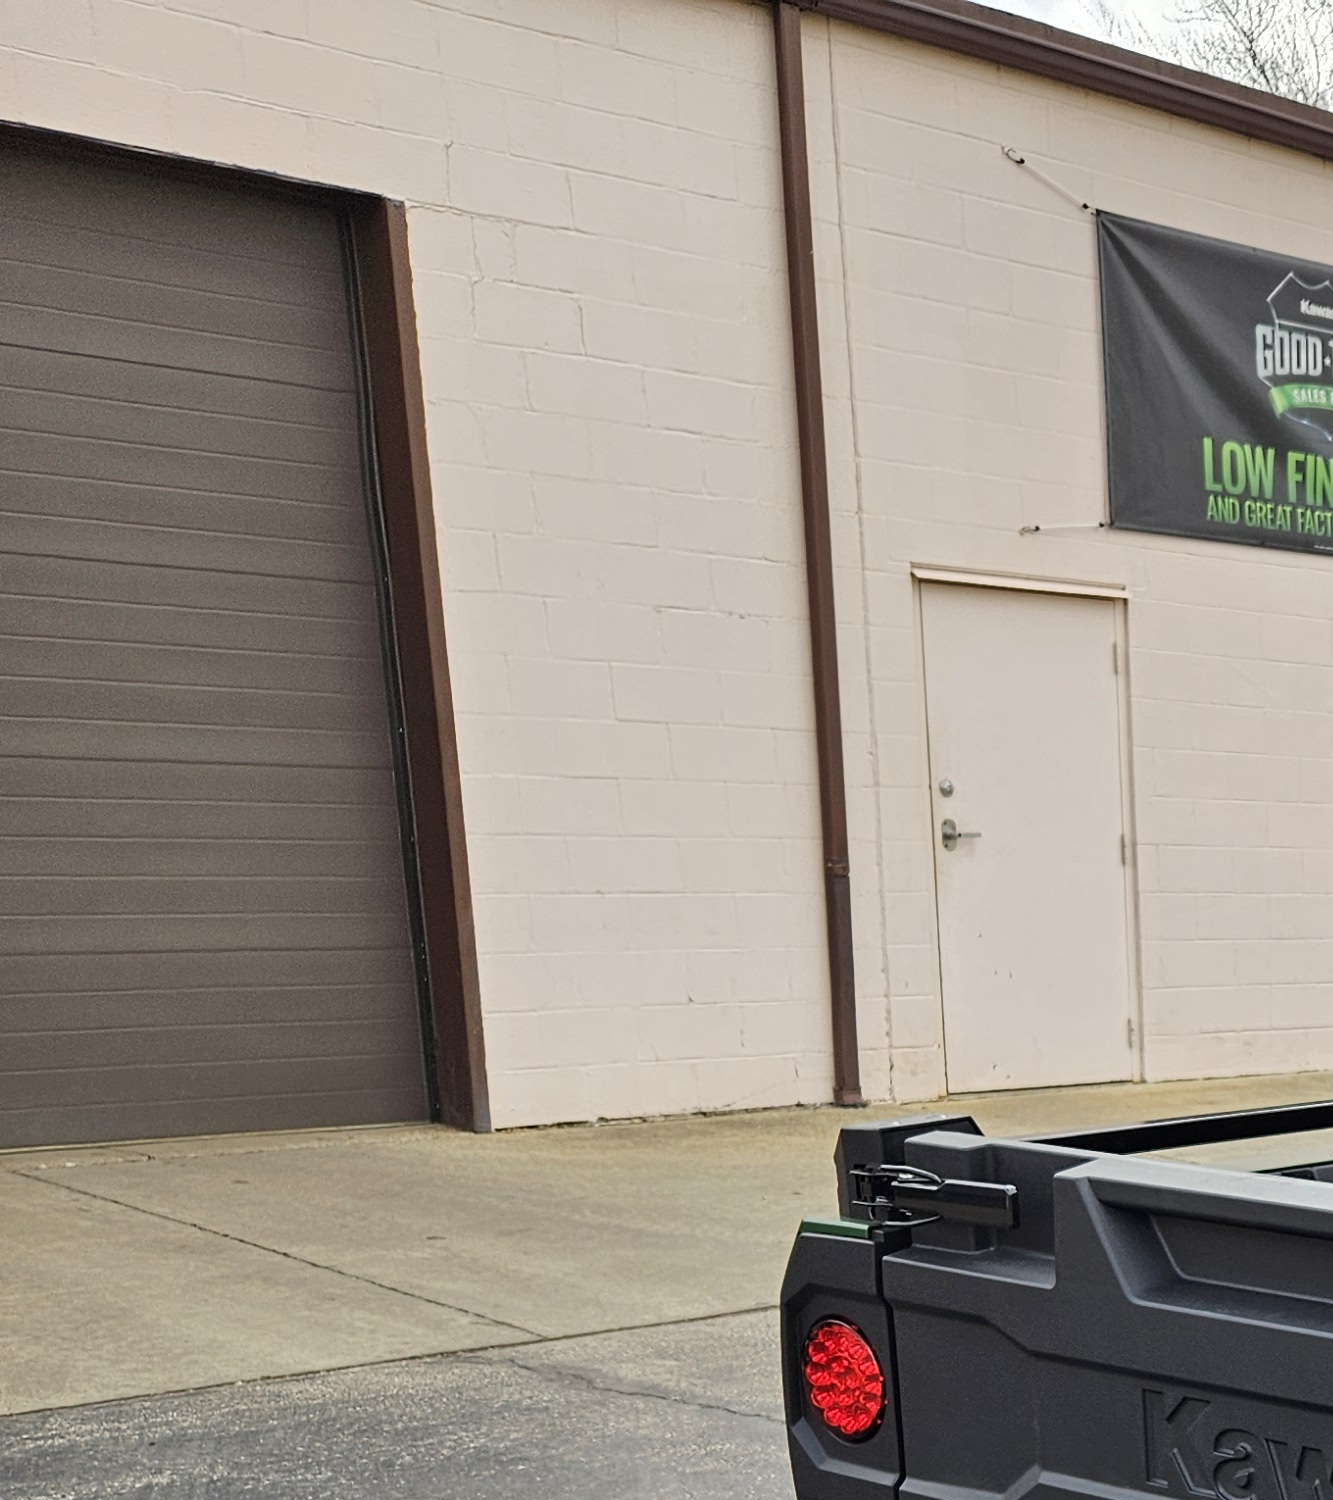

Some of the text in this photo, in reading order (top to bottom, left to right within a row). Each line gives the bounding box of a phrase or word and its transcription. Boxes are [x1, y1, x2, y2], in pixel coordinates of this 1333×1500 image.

[1255, 323, 1323, 377] GOOD
[1292, 387, 1327, 406] SALES
[1203, 437, 1275, 500] LOW
[1206, 494, 1240, 525] AND
[1244, 501, 1293, 532] GREAT
